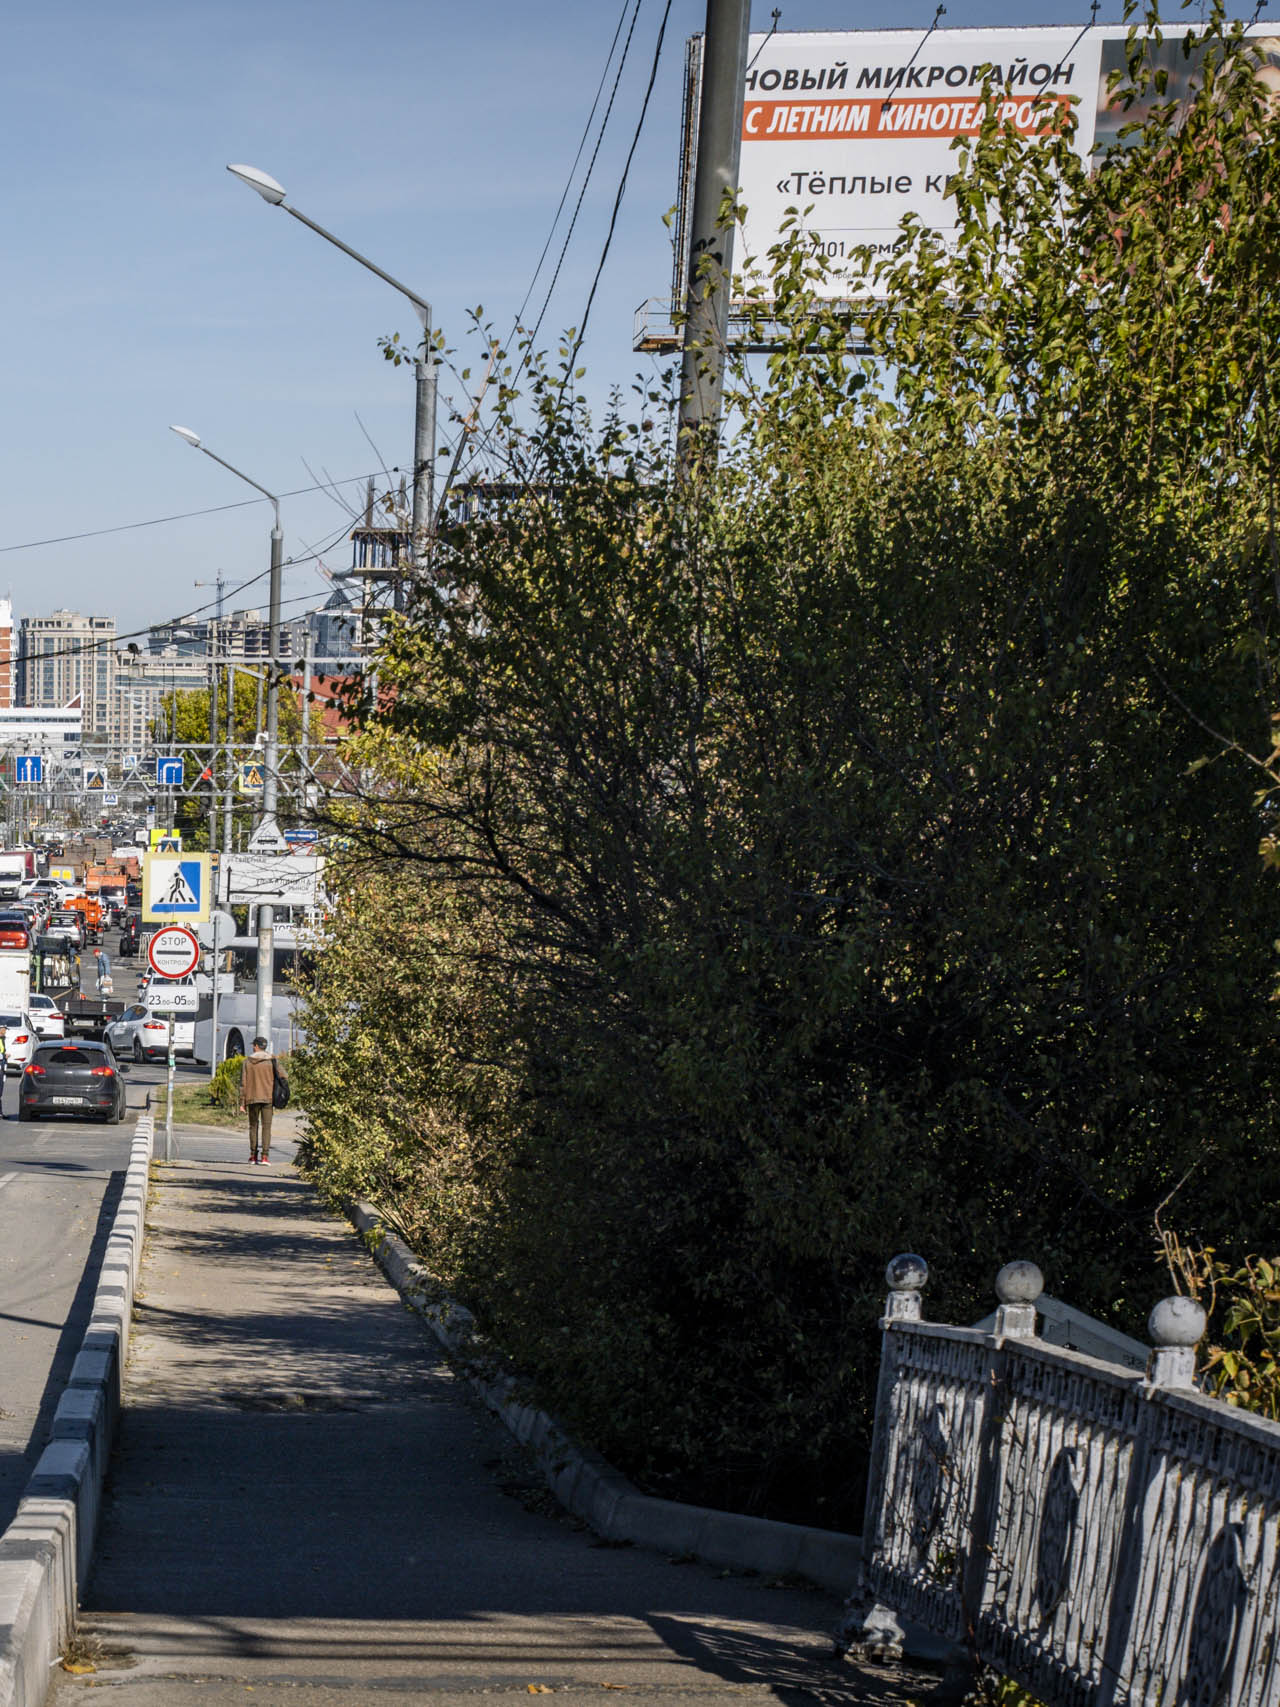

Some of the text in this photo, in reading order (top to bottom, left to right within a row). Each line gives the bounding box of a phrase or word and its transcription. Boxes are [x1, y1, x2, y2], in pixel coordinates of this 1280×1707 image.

[856, 57, 1075, 88] МИКРОРАЙОН
[745, 107, 762, 133] С
[766, 105, 871, 133] ЛЕТНИМ
[776, 171, 913, 195] «Тёплые
[161, 937, 187, 946] STOP
